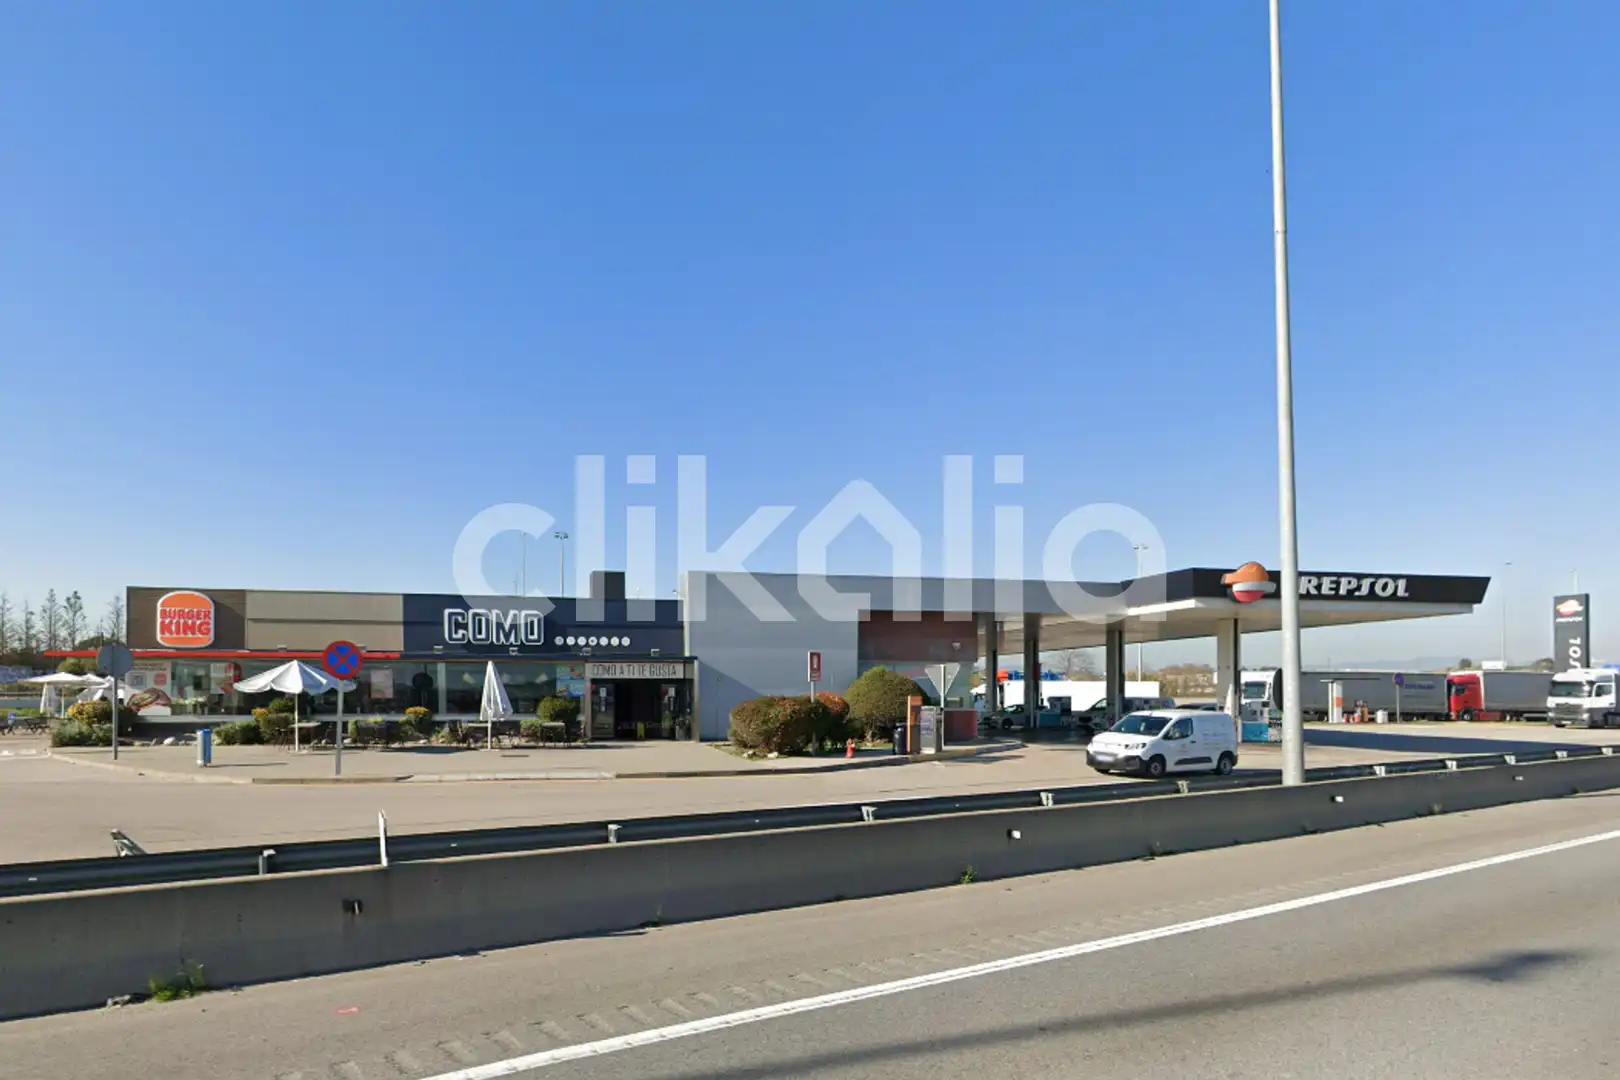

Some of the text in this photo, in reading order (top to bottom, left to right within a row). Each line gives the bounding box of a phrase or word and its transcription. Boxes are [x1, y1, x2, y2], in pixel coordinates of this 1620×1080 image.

[1298, 576, 1409, 597] REPSOL
[159, 608, 211, 620] BURGER
[159, 621, 211, 636] KING
[443, 608, 545, 645] COMO
